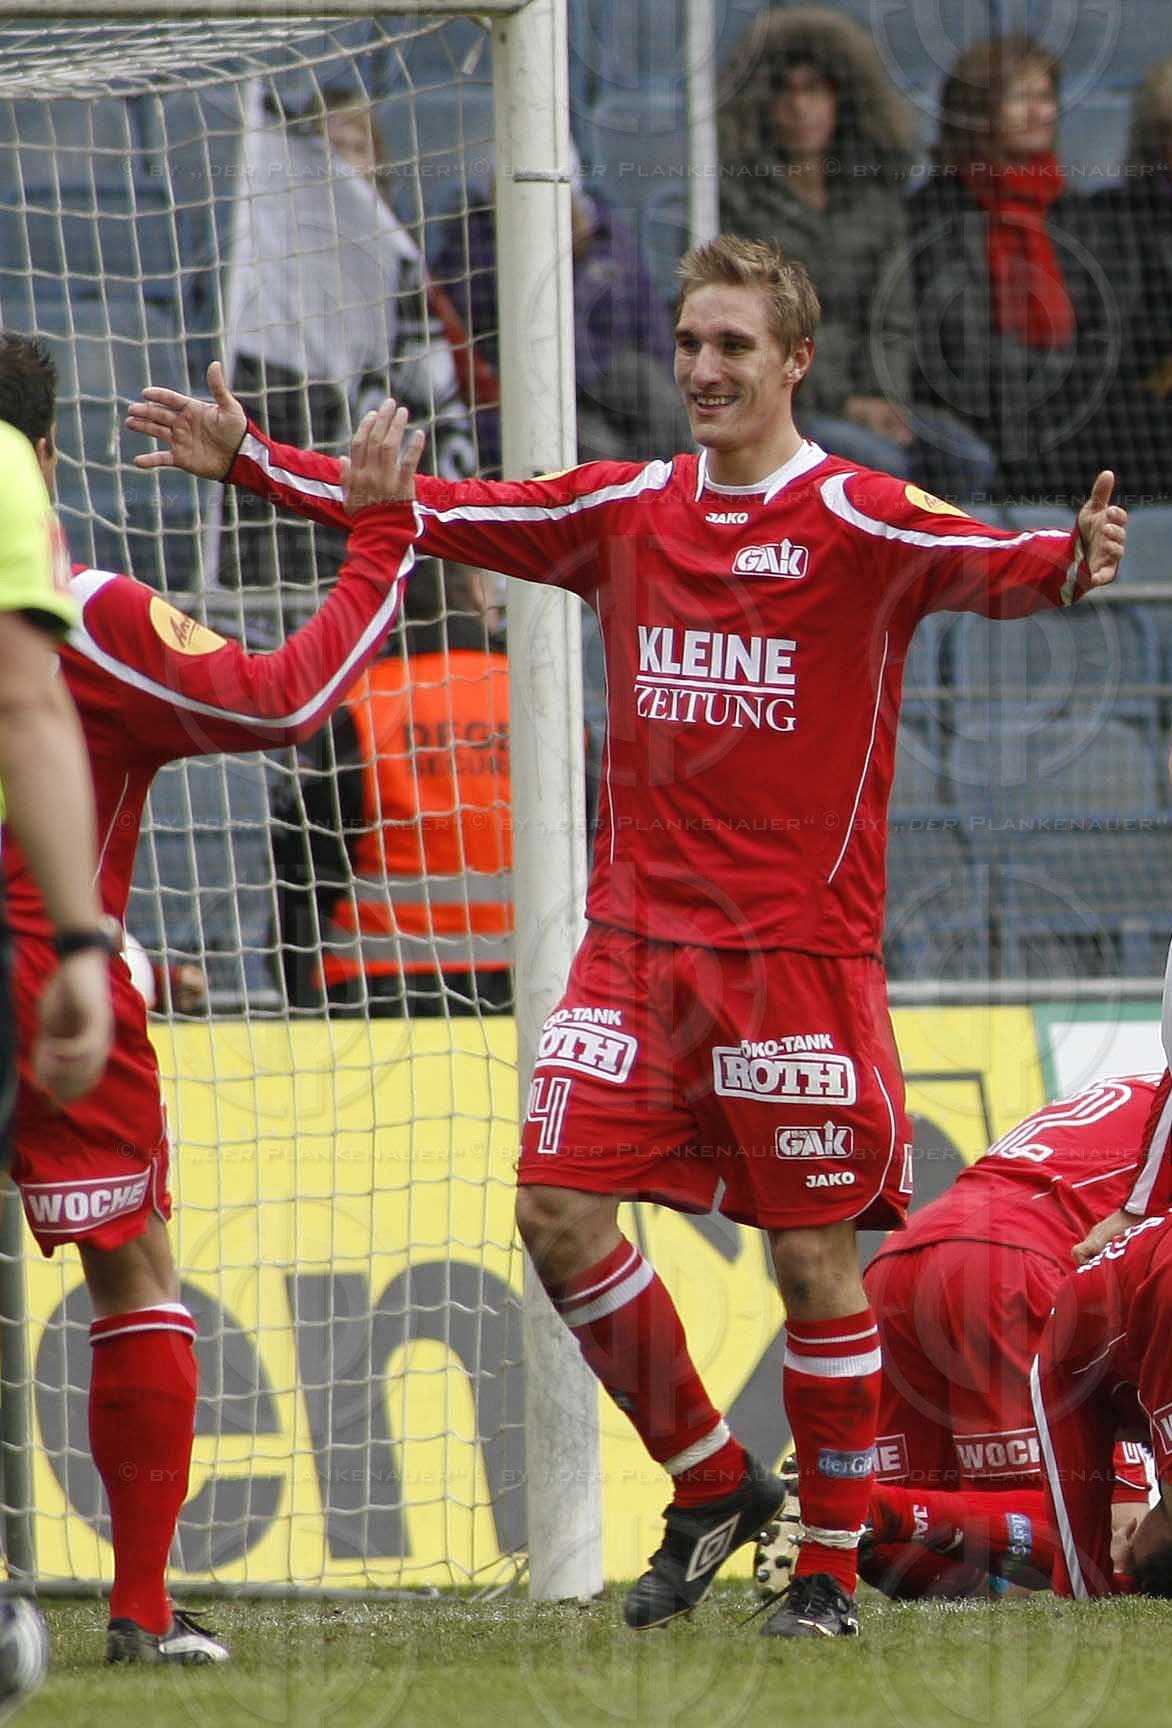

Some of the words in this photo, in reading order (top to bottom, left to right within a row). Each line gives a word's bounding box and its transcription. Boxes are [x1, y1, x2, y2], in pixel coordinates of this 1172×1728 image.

[705, 512, 749, 524] JAKO
[736, 538, 804, 576] GAK
[637, 625, 797, 685] KLEINE
[634, 684, 796, 732] ZEITUNG
[722, 1056, 845, 1097] ROTH
[778, 1120, 849, 1156] GAK
[805, 1172, 856, 1188] JAKO
[28, 1181, 146, 1224] WOCHE
